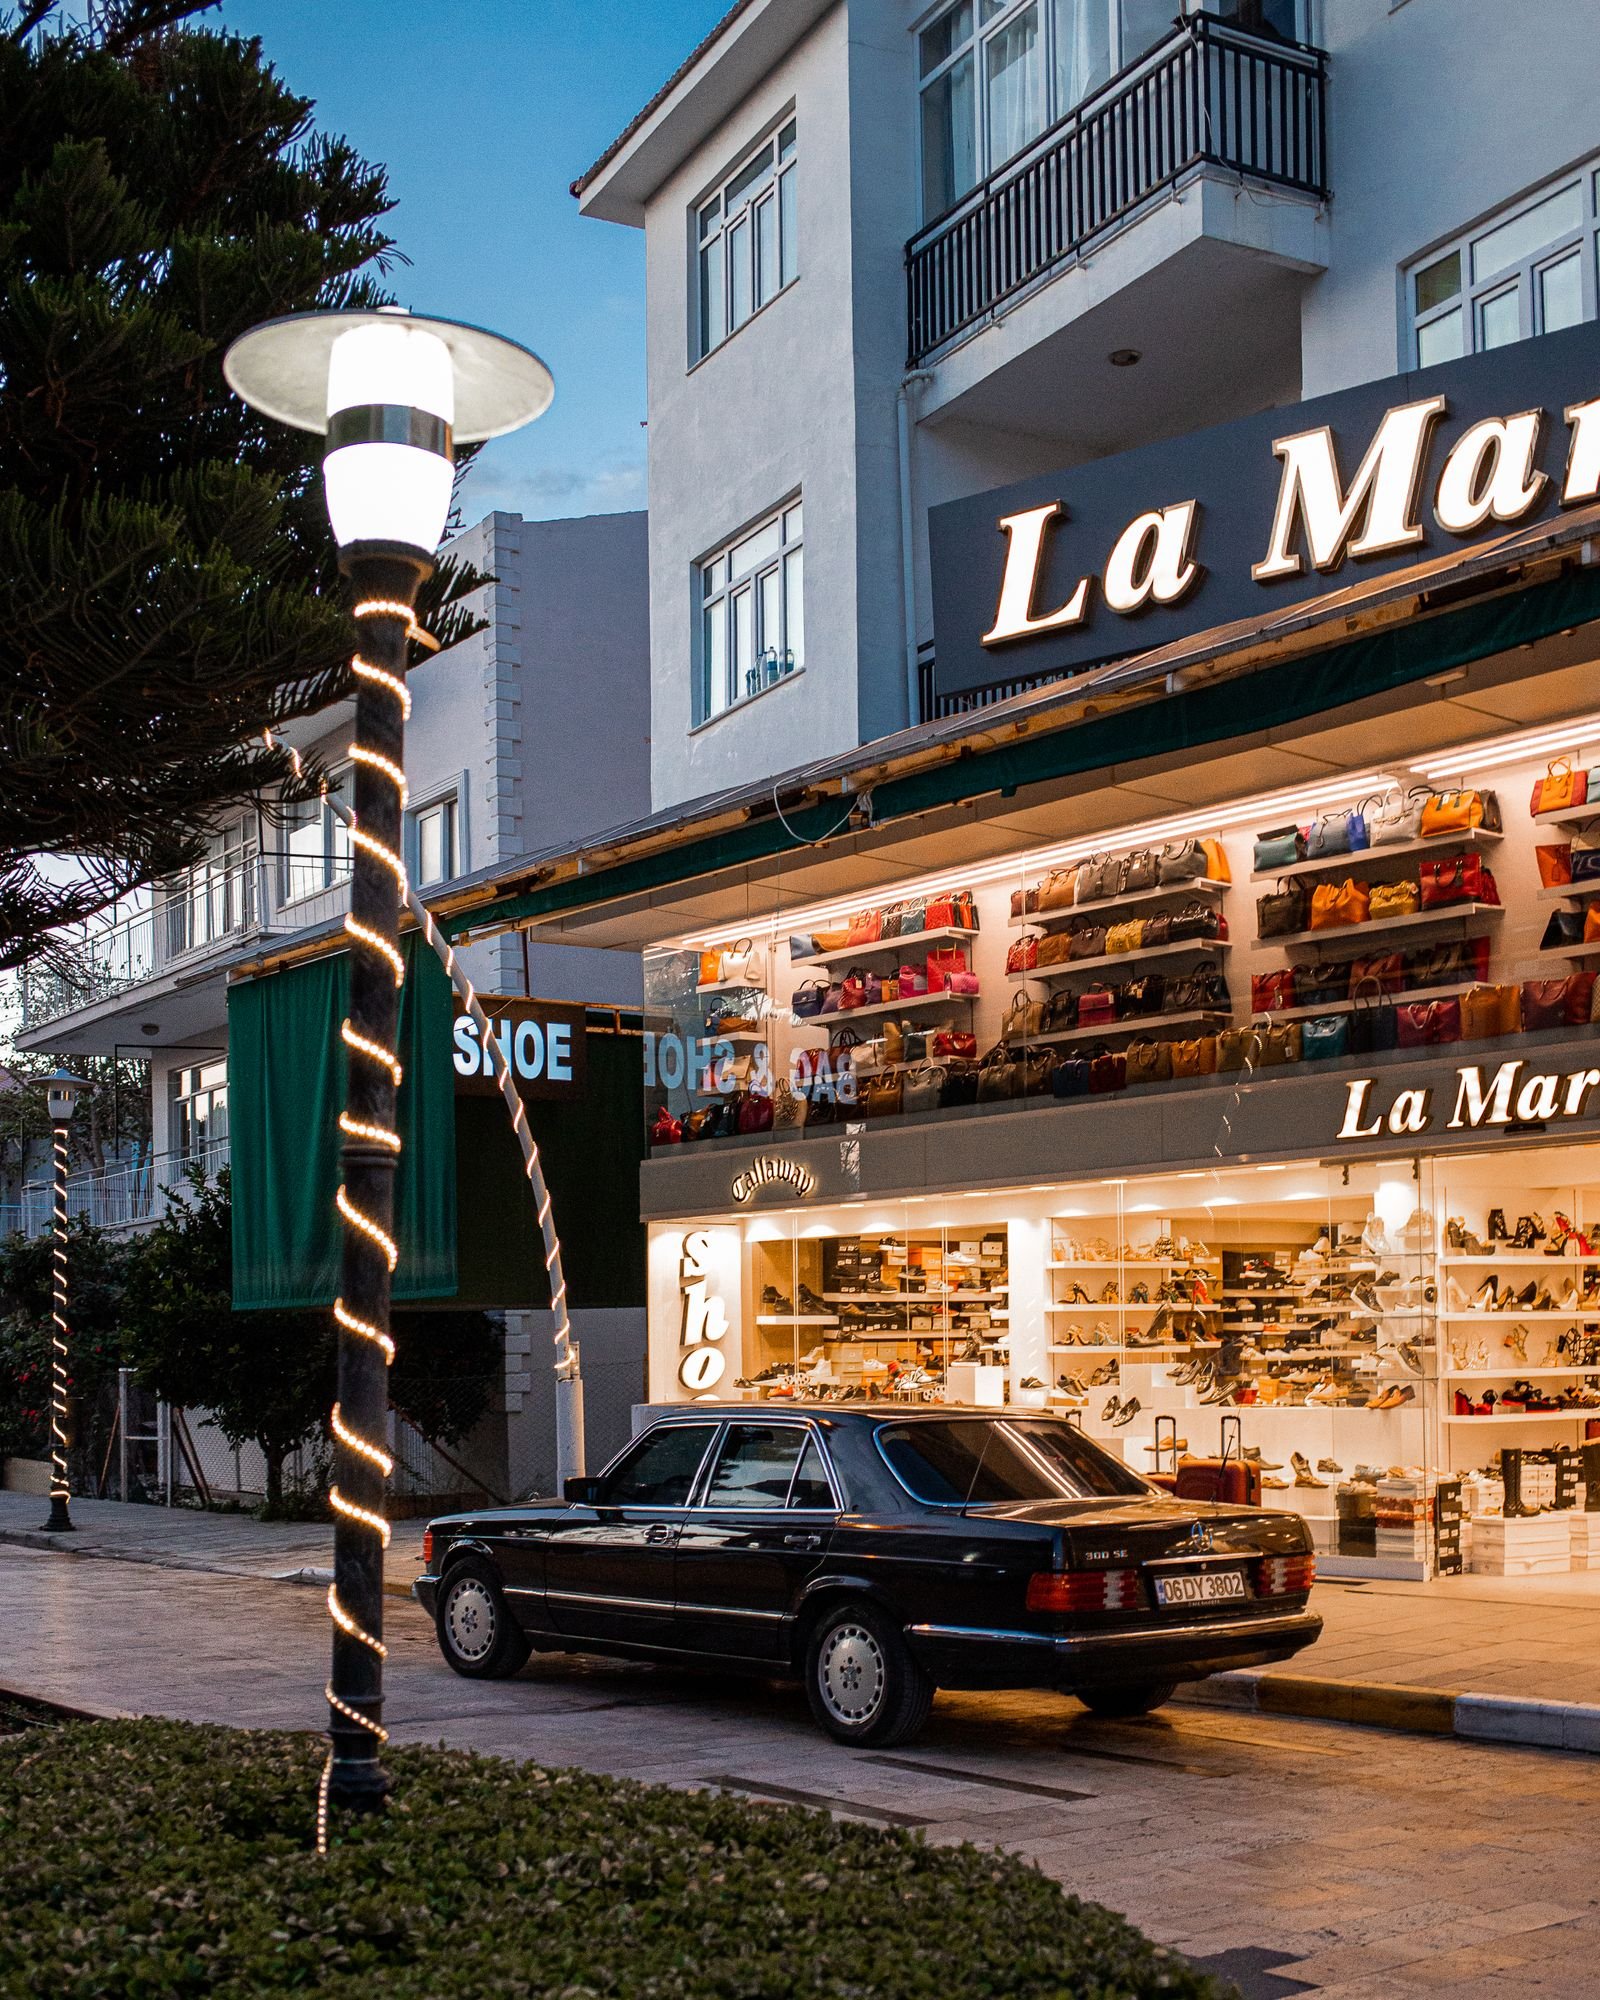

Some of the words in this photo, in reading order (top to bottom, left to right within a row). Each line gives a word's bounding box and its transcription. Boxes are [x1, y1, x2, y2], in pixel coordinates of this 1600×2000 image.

[980, 498, 1202, 648] La
[453, 1015, 572, 1080] SHOE
[1336, 1078, 1430, 1139] La
[1447, 1060, 1600, 1128] Mar
[732, 1155, 815, 1203] Callaway
[1085, 1551, 1110, 1560] 300
[1113, 1549, 1128, 1558] SE
